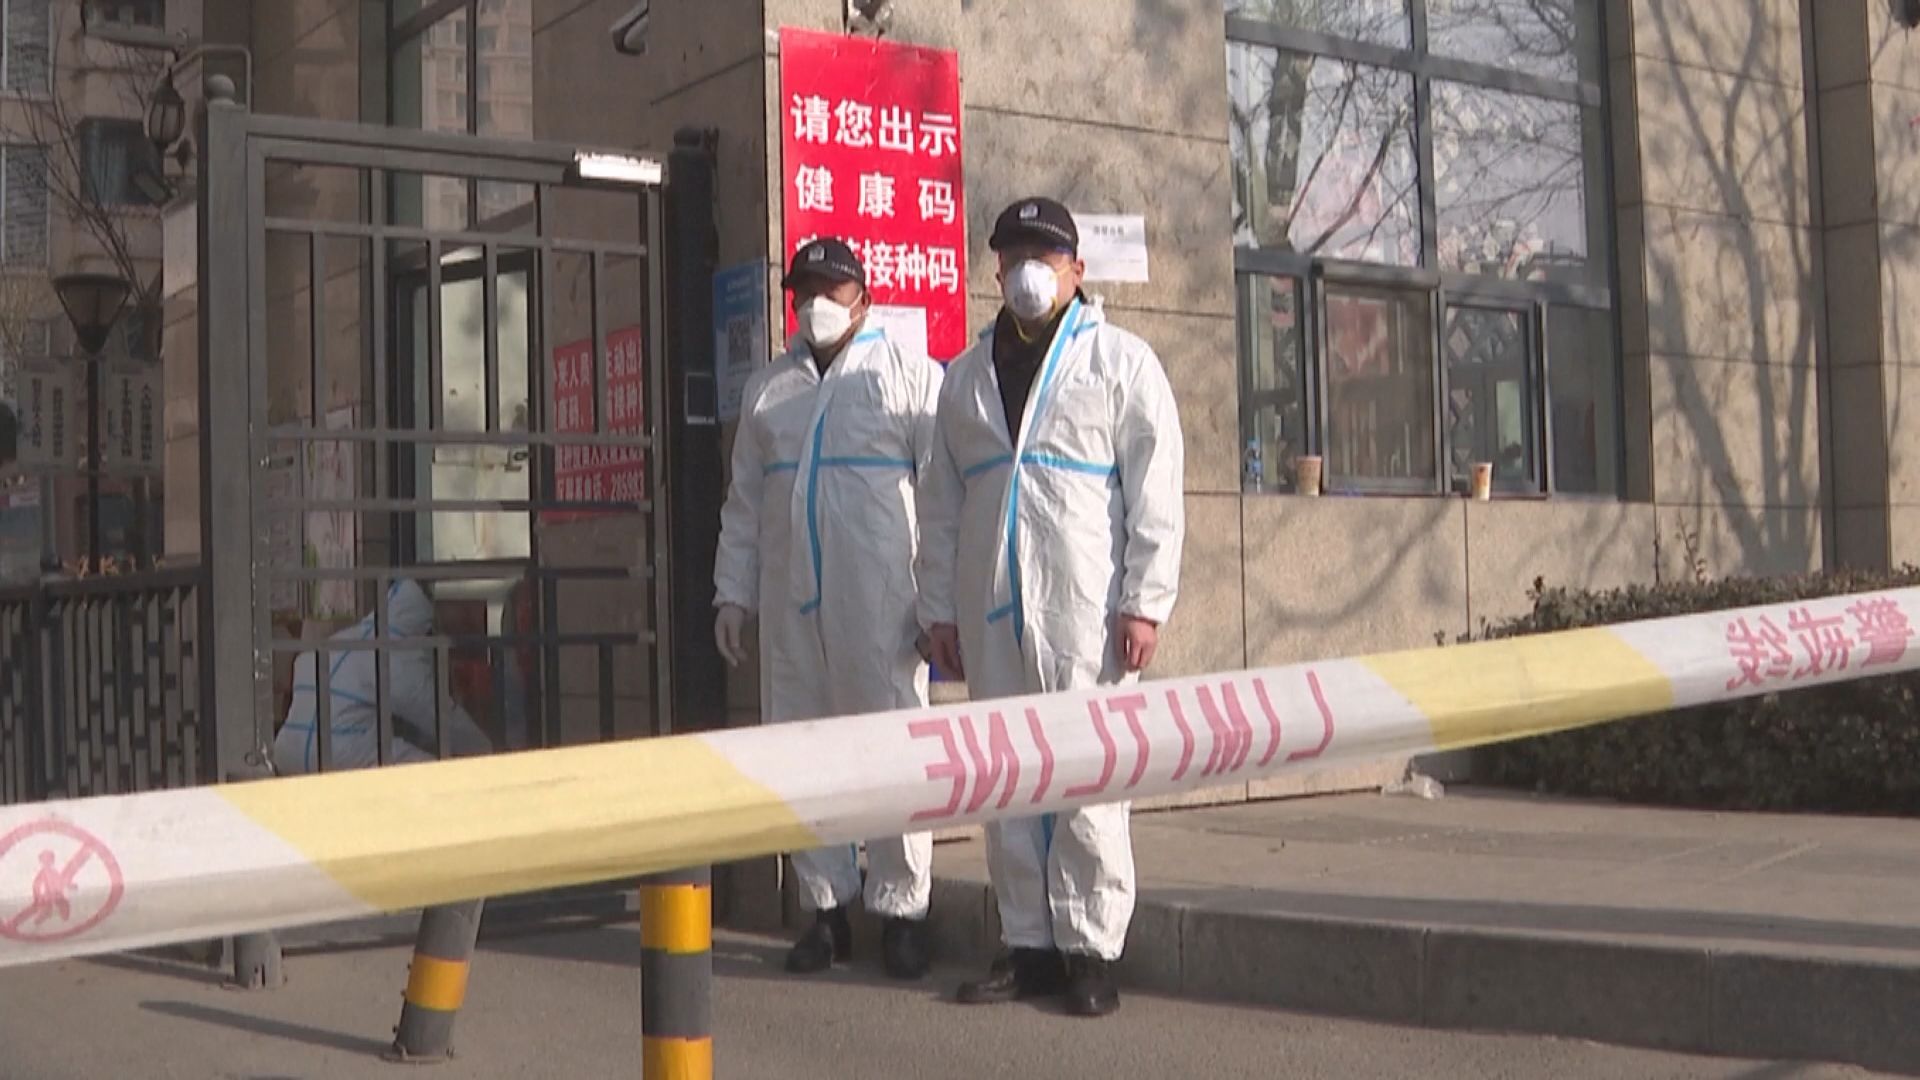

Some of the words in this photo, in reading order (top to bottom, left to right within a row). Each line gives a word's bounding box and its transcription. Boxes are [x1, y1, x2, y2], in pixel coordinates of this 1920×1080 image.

[791, 94, 957, 156] 请您出示
[795, 163, 955, 224] 健康码
[796, 233, 959, 294] 接种码
